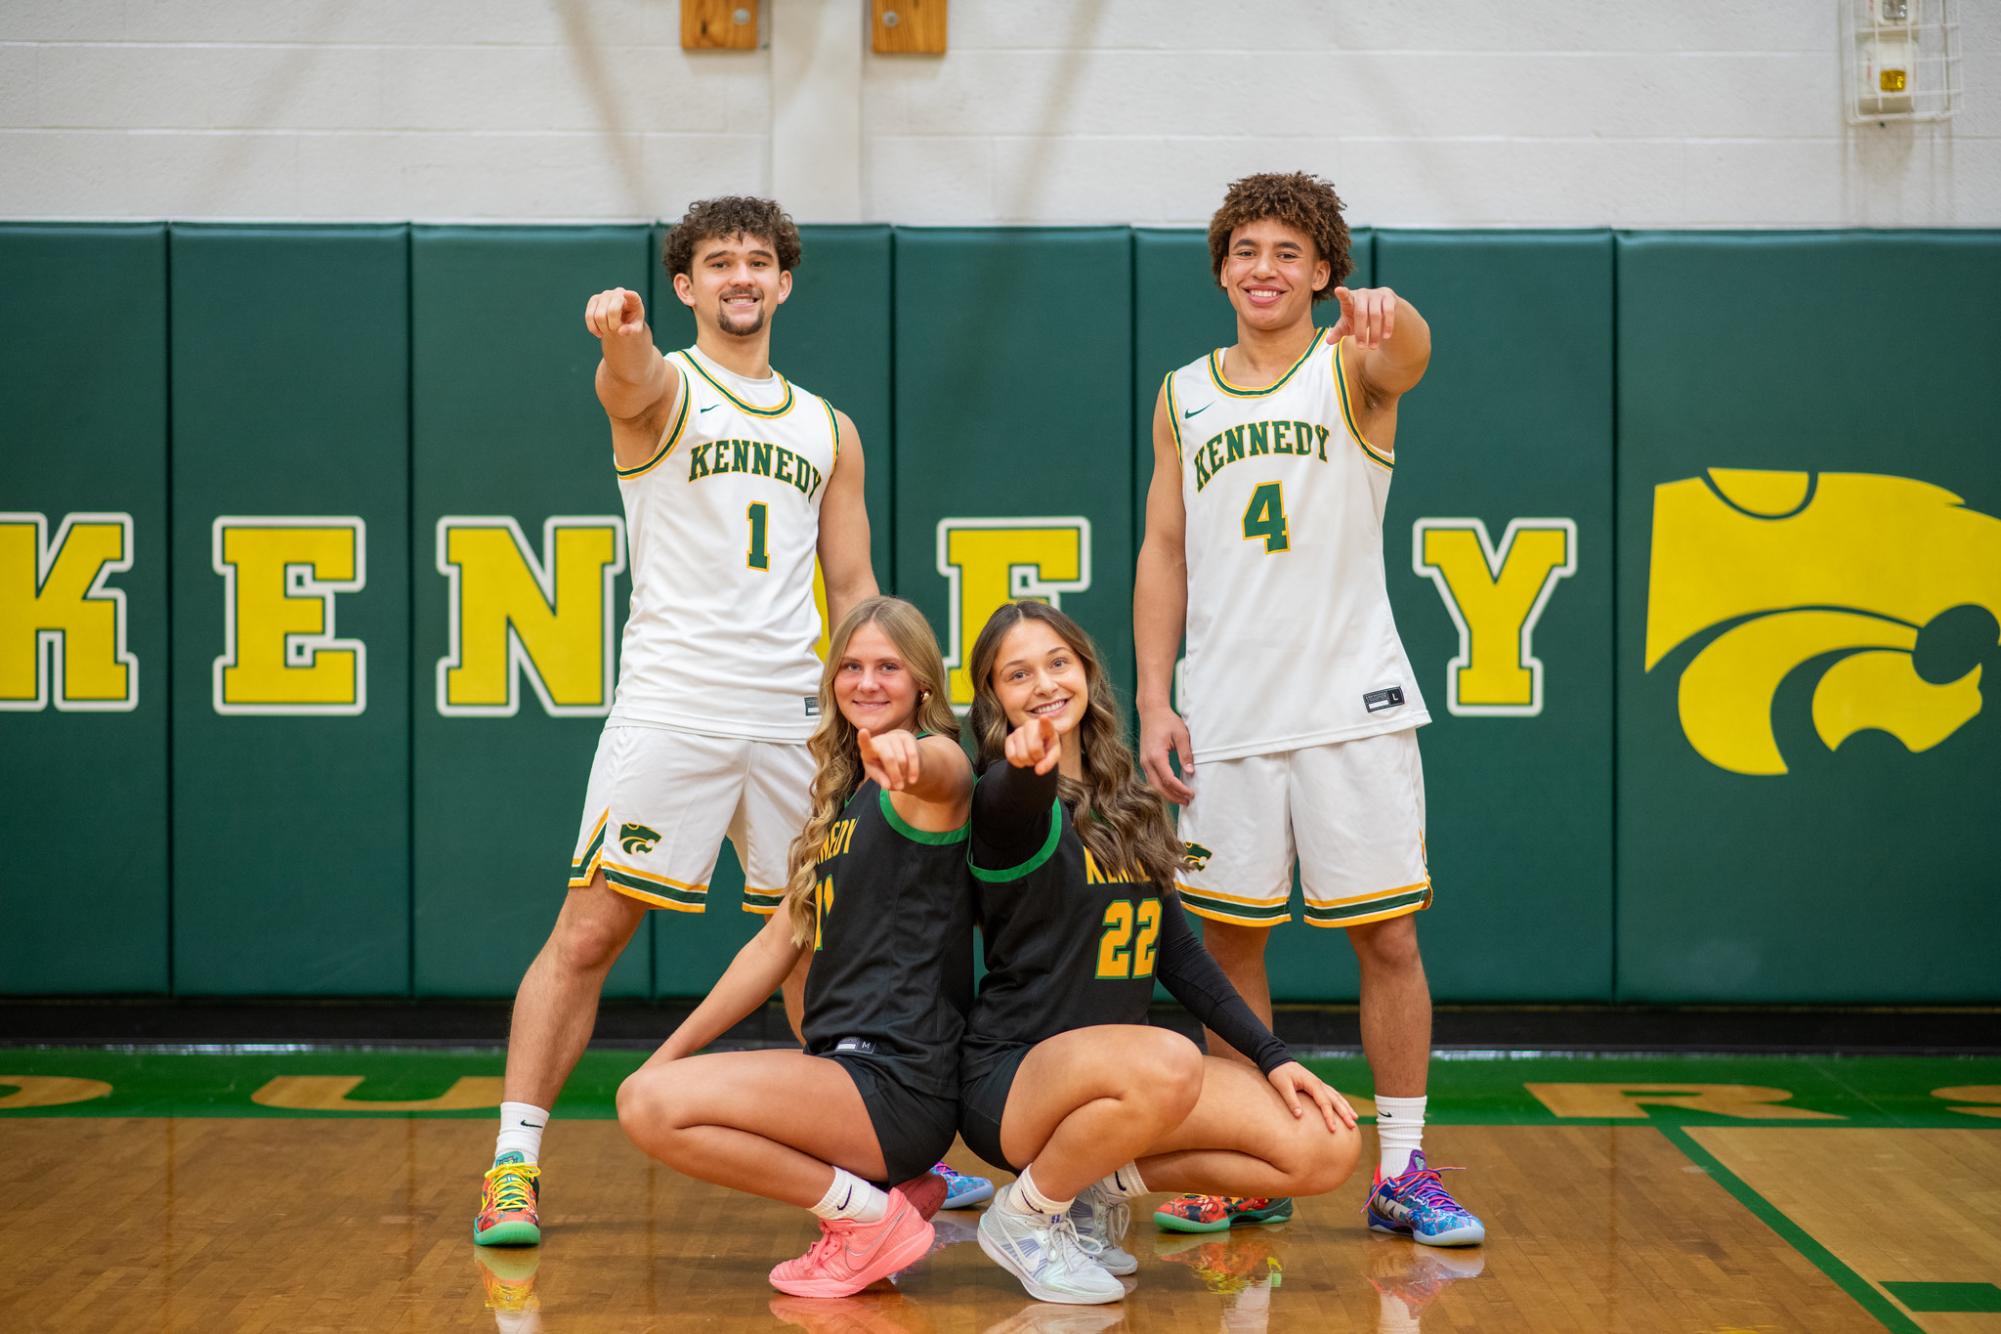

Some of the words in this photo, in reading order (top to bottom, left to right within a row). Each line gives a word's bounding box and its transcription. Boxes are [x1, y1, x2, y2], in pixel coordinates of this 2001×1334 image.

[688, 439, 822, 504] KENNEDY
[1194, 420, 1330, 493] KENNEDY
[746, 500, 770, 573] 1
[1242, 480, 1291, 555] 4
[0, 511, 1578, 718] KENEY
[1094, 897, 1163, 980] 22
